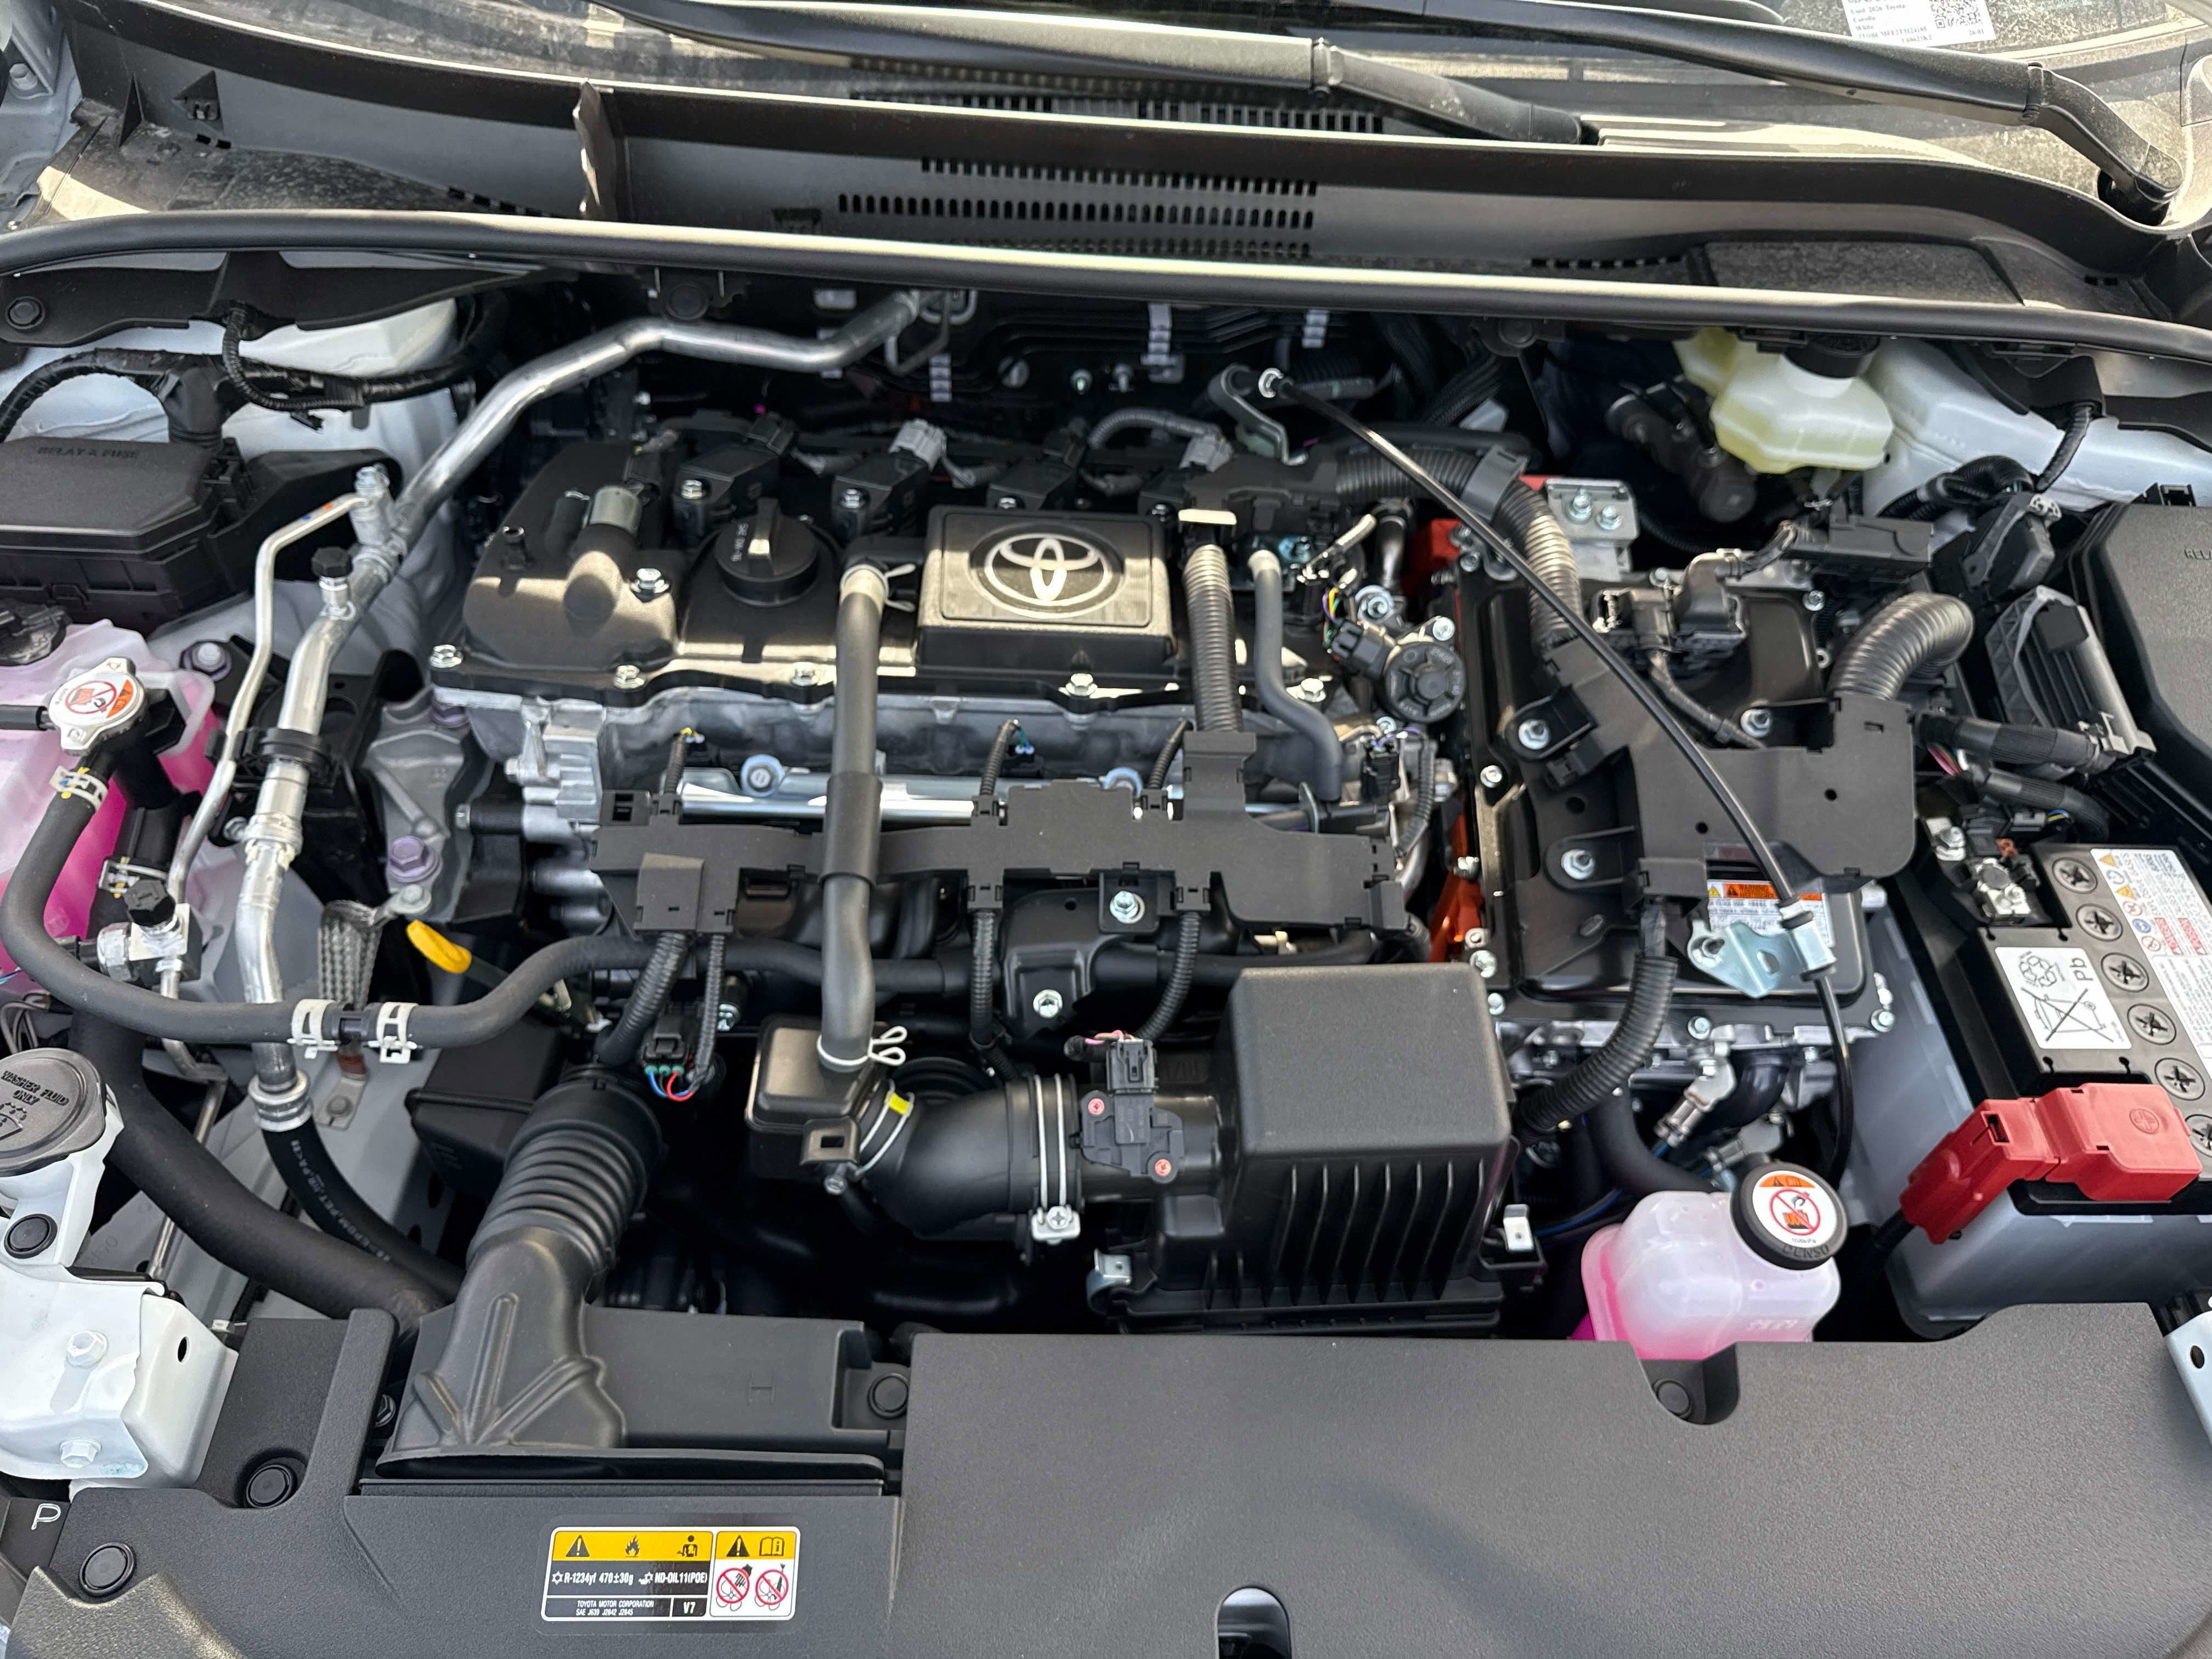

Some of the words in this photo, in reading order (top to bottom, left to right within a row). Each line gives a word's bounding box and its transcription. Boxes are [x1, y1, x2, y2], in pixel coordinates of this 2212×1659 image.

[38, 447, 85, 456] RELAY
[102, 448, 139, 458] FUSE
[737, 522, 749, 536] SAE
[2069, 957, 2094, 981] Pb
[1, 1070, 41, 1093] WASHER
[40, 1089, 69, 1106] FLUID
[13, 1090, 40, 1105] ONLY
[31, 1503, 61, 1530] P
[563, 1572, 597, 1585] R-1234yf
[599, 1572, 634, 1585] 470±30g
[654, 1572, 708, 1584] ND-OIL11(POE)
[683, 1601, 696, 1614] V7
